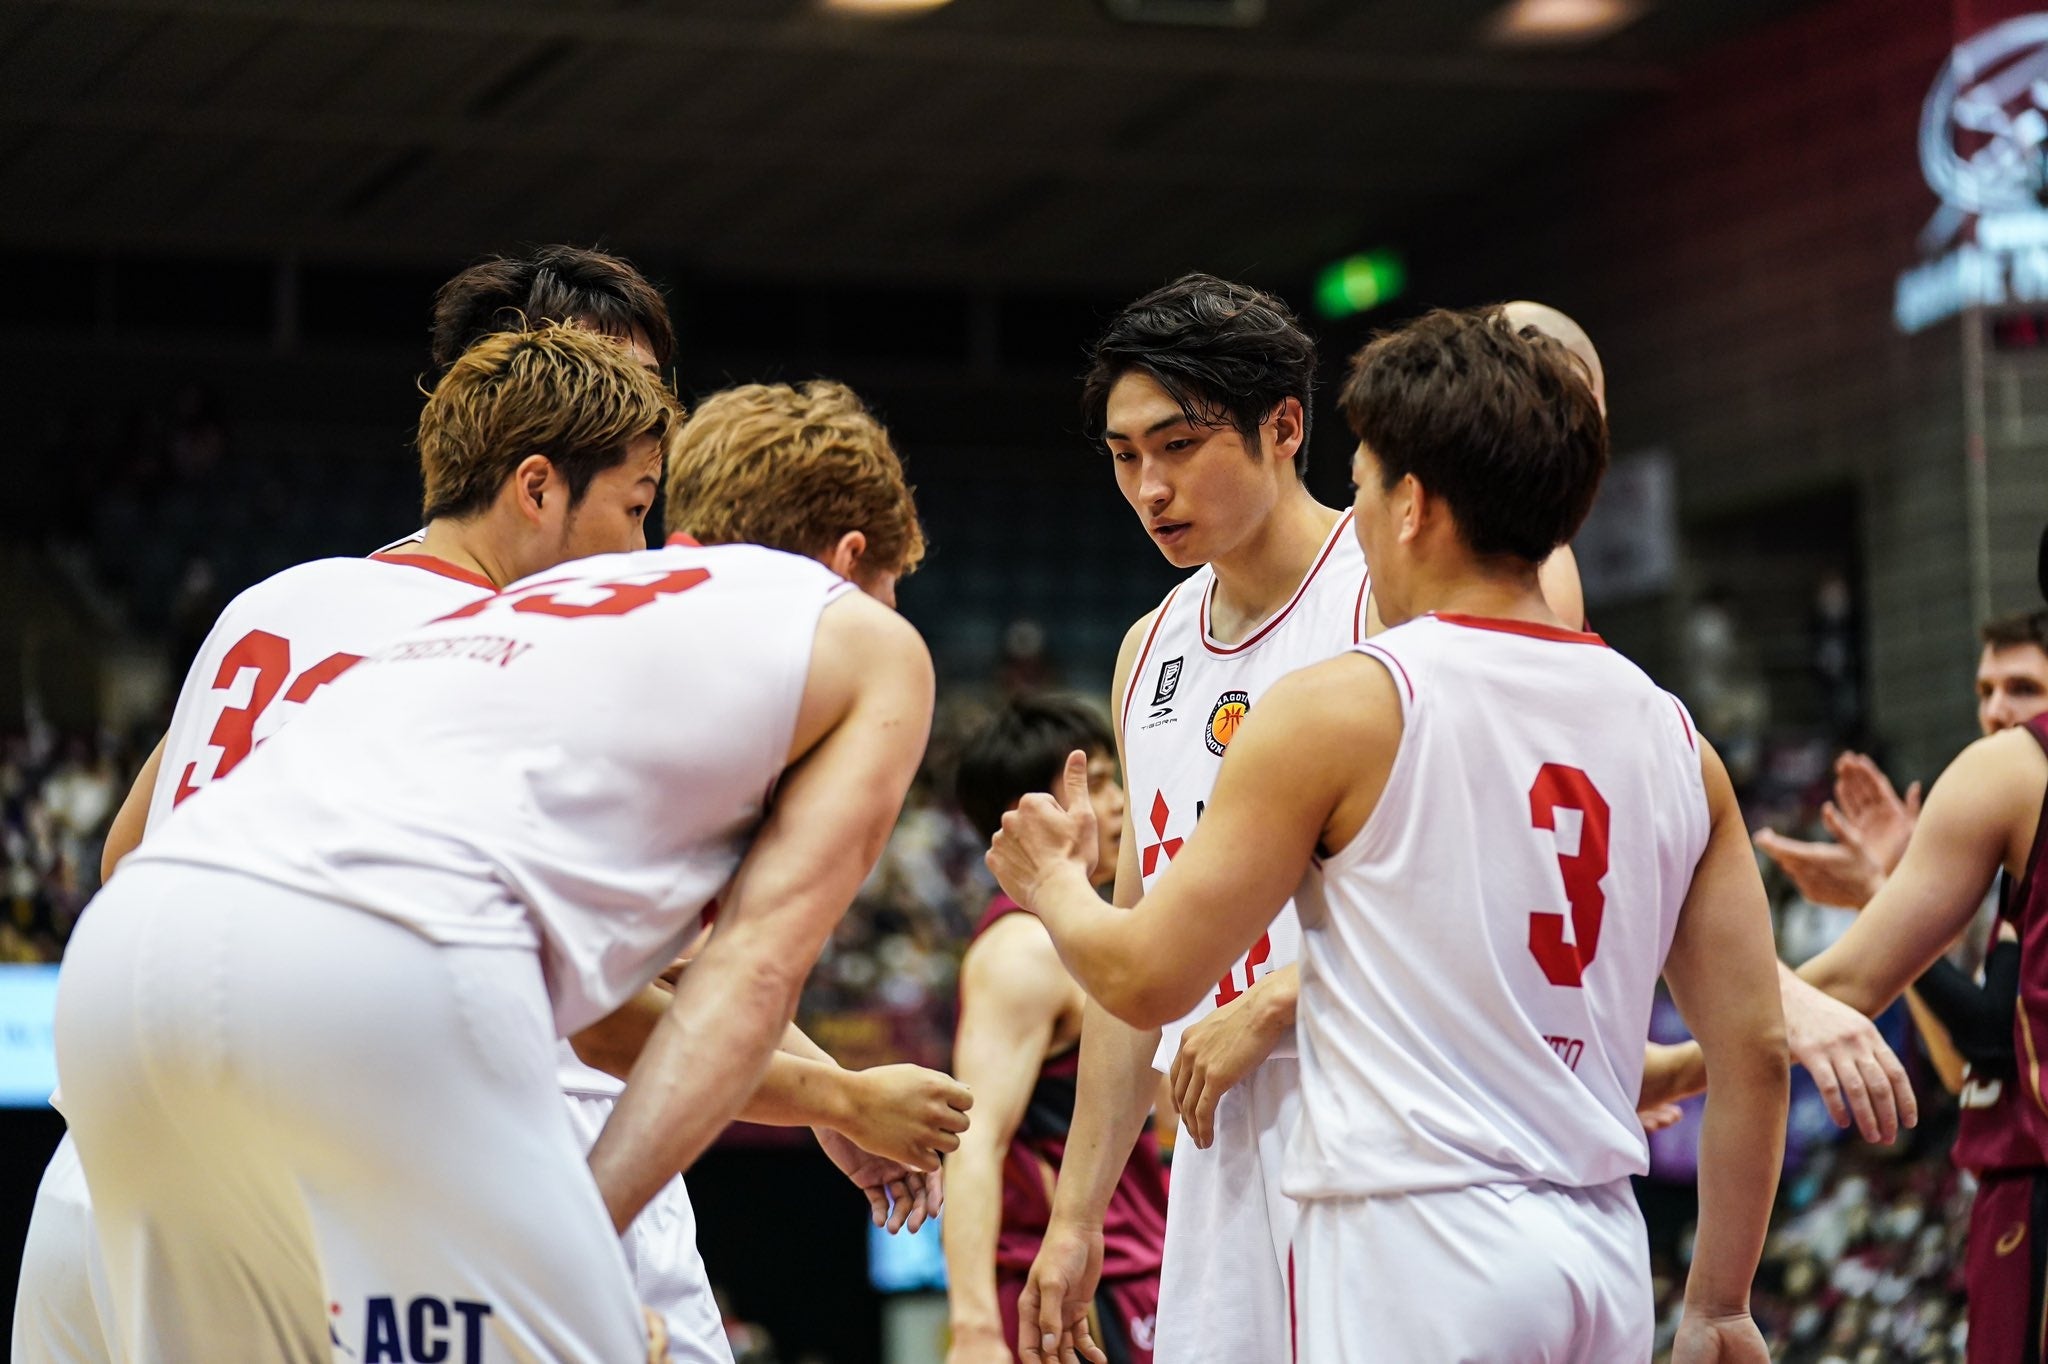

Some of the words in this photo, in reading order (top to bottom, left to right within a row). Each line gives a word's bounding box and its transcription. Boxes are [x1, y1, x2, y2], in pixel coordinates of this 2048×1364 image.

[1141, 718, 1178, 731] TIGORA
[1528, 762, 1611, 988] 3
[364, 1296, 493, 1364] ACT
